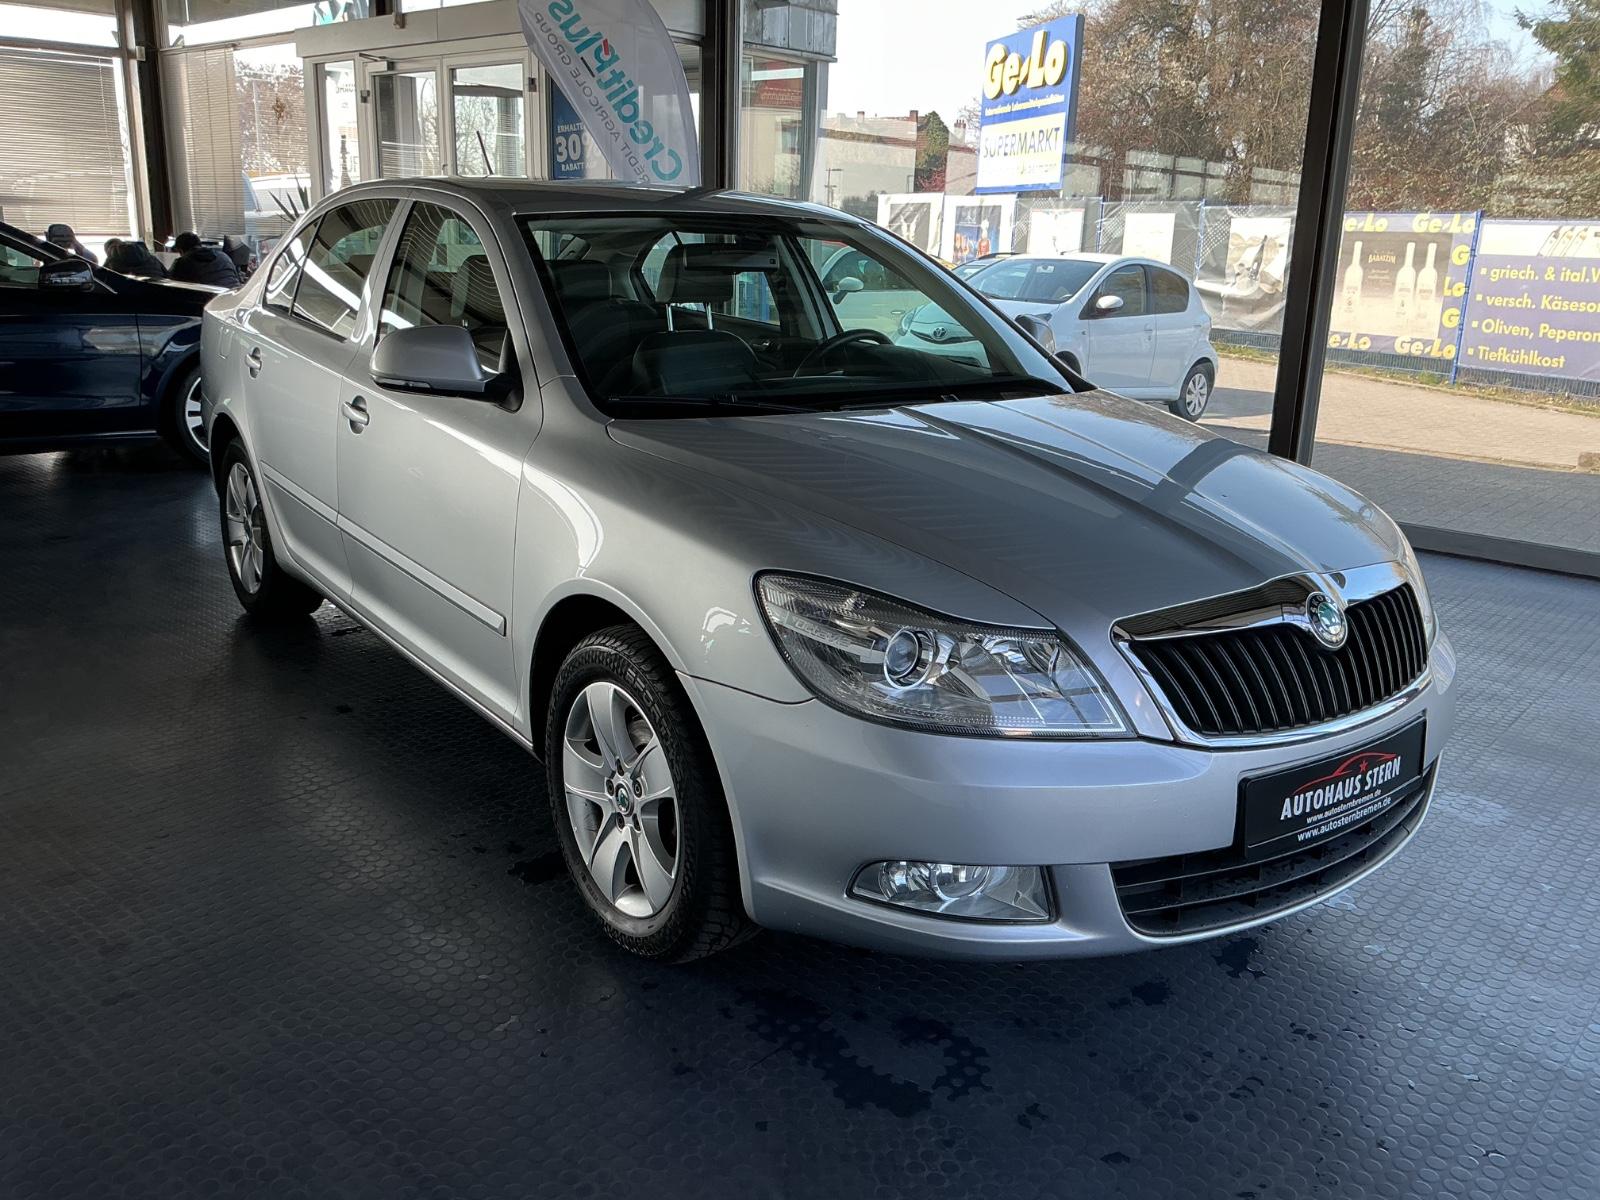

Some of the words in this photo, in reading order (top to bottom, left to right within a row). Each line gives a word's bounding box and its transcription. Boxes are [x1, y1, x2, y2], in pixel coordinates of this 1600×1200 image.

[983, 127, 1061, 159] SUPERMARKT
[1490, 264, 1539, 281] griech.
[1544, 266, 1556, 281] &
[1486, 293, 1536, 309] versch.
[1482, 318, 1534, 339] Oliven,
[1478, 345, 1566, 369] Tiefkühlkost
[1280, 774, 1362, 820] AUTOHAUS
[1364, 756, 1401, 791] STERN
[1297, 796, 1392, 842] www.autosternbremen.de
[1306, 789, 1382, 824] www.autosternbremen.de
